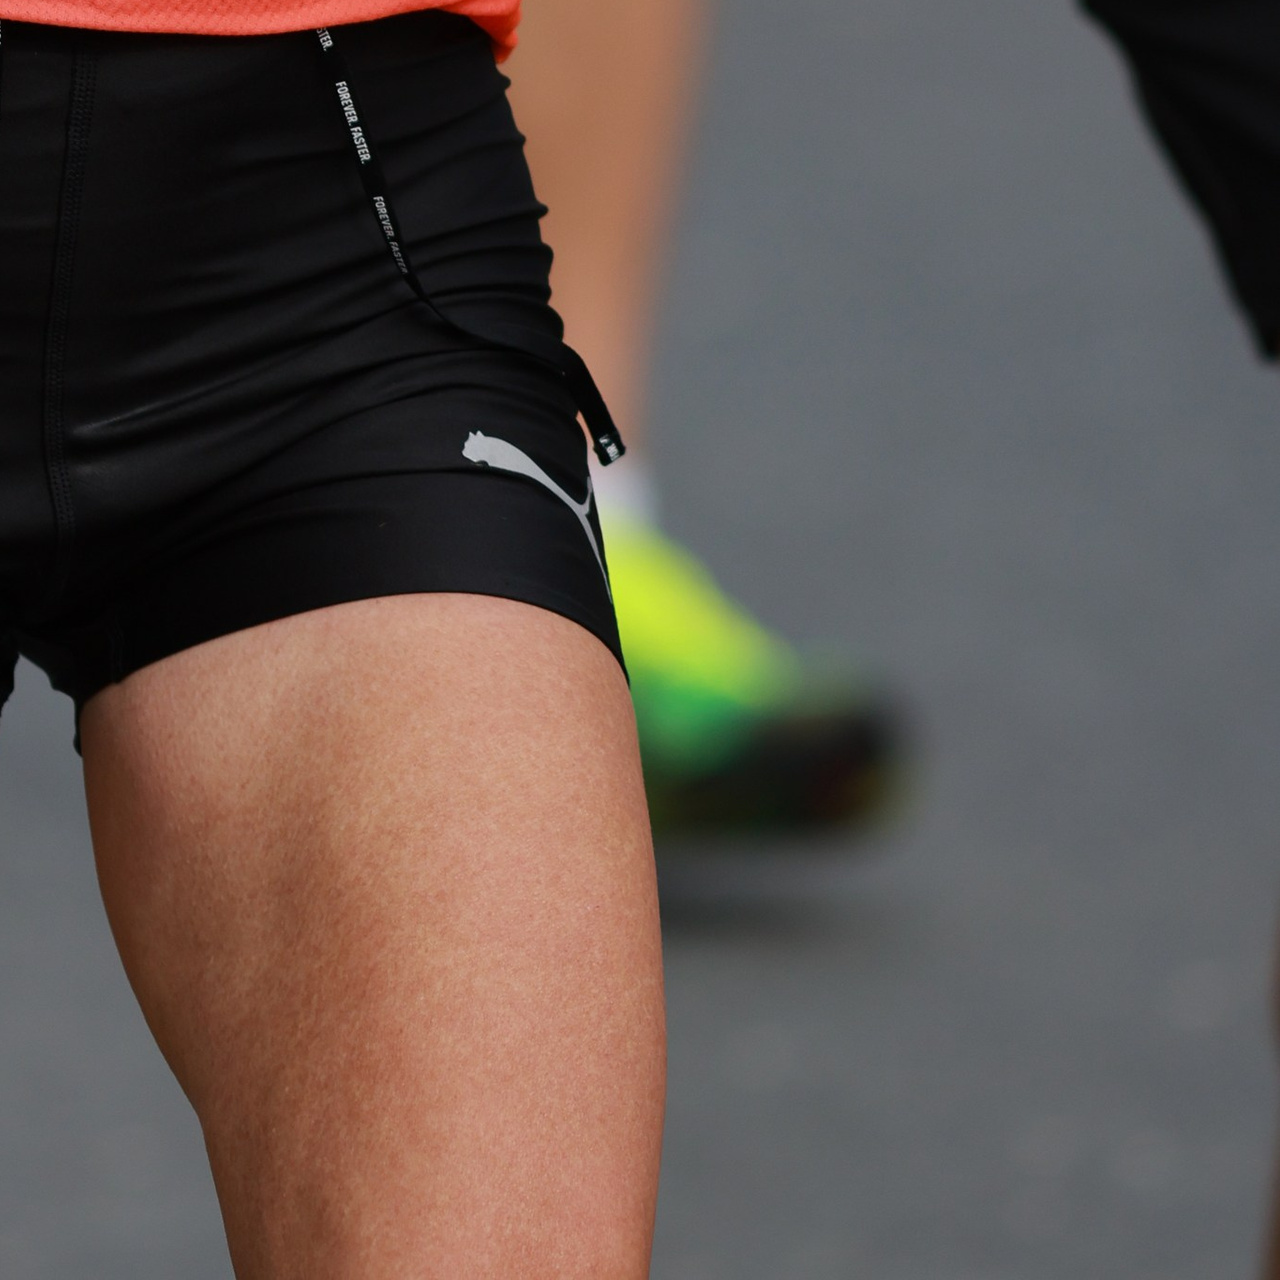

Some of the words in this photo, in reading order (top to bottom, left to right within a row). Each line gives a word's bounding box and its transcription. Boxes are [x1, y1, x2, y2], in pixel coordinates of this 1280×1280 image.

[335, 80, 358, 127] FOREVER.
[350, 126, 371, 165] FASTER.
[373, 195, 394, 240] FOREVER.
